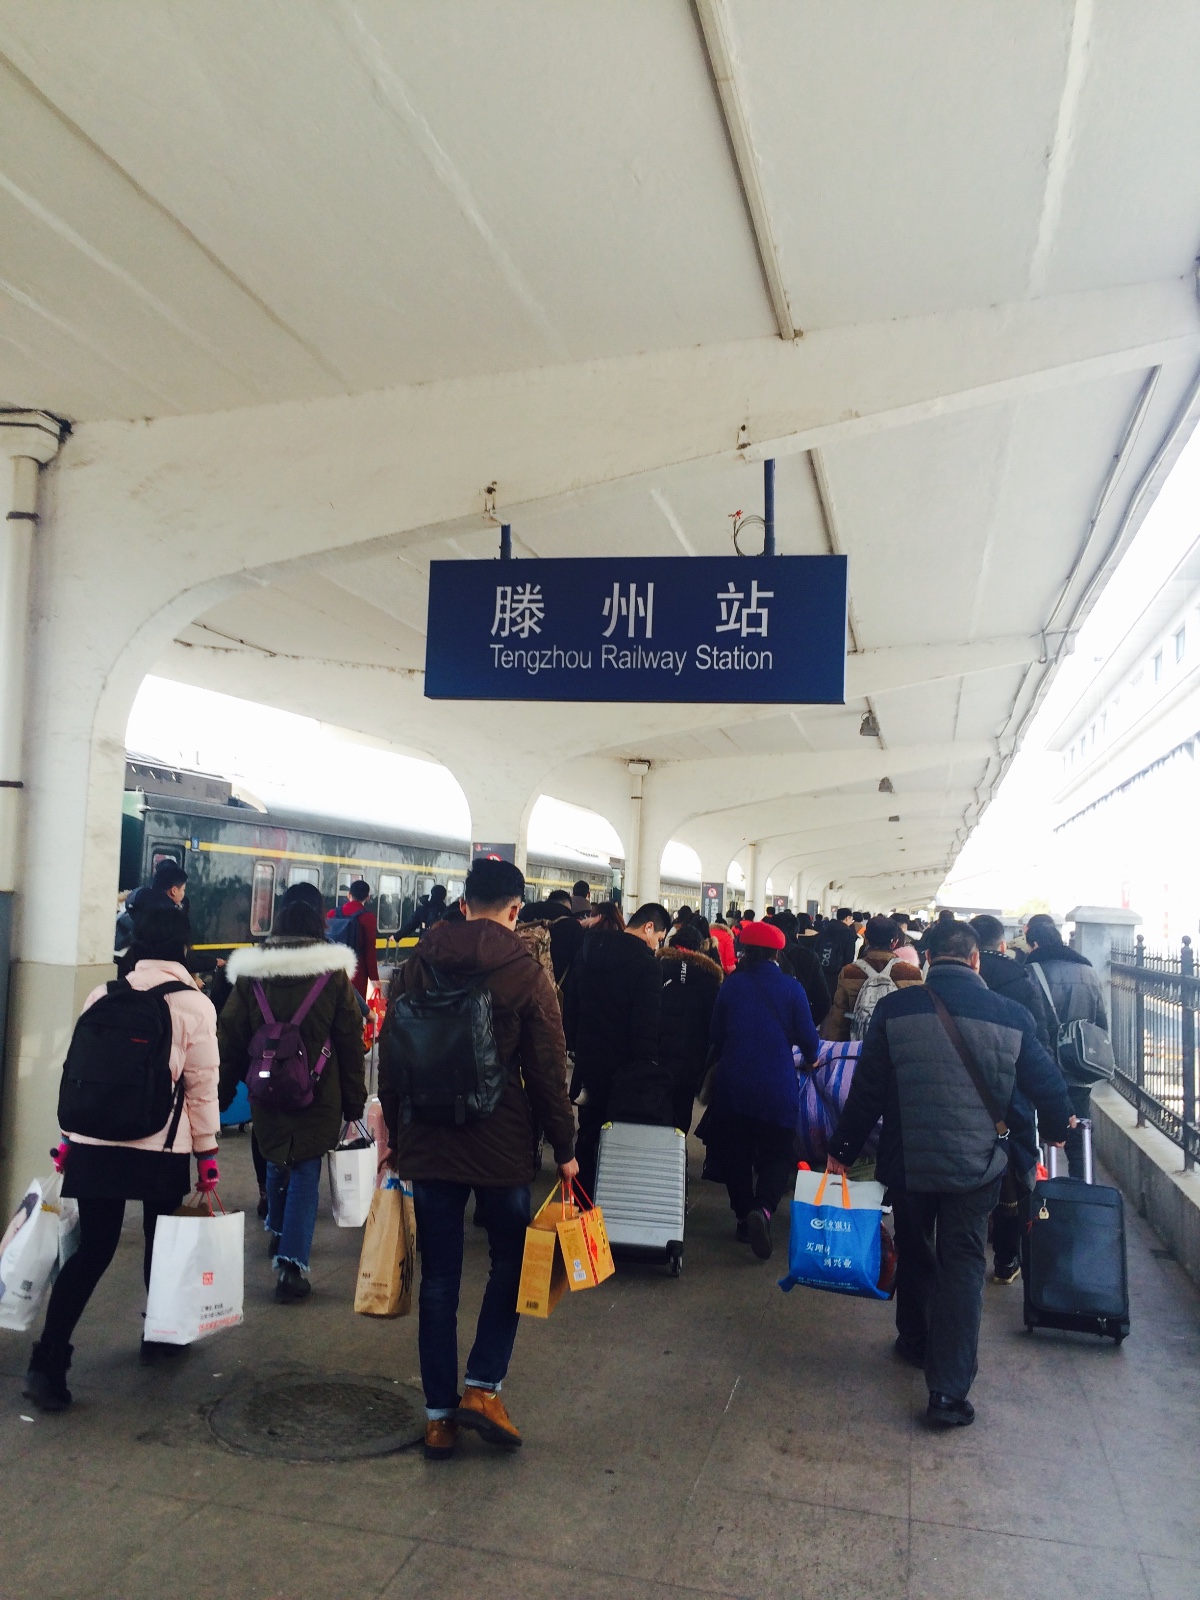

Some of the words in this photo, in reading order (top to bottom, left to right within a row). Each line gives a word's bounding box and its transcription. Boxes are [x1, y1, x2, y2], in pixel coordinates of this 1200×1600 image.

[490, 579, 774, 639] 滕州站
[489, 643, 592, 675] Tengzhou
[601, 644, 687, 676] Railway
[695, 643, 773, 670] Station
